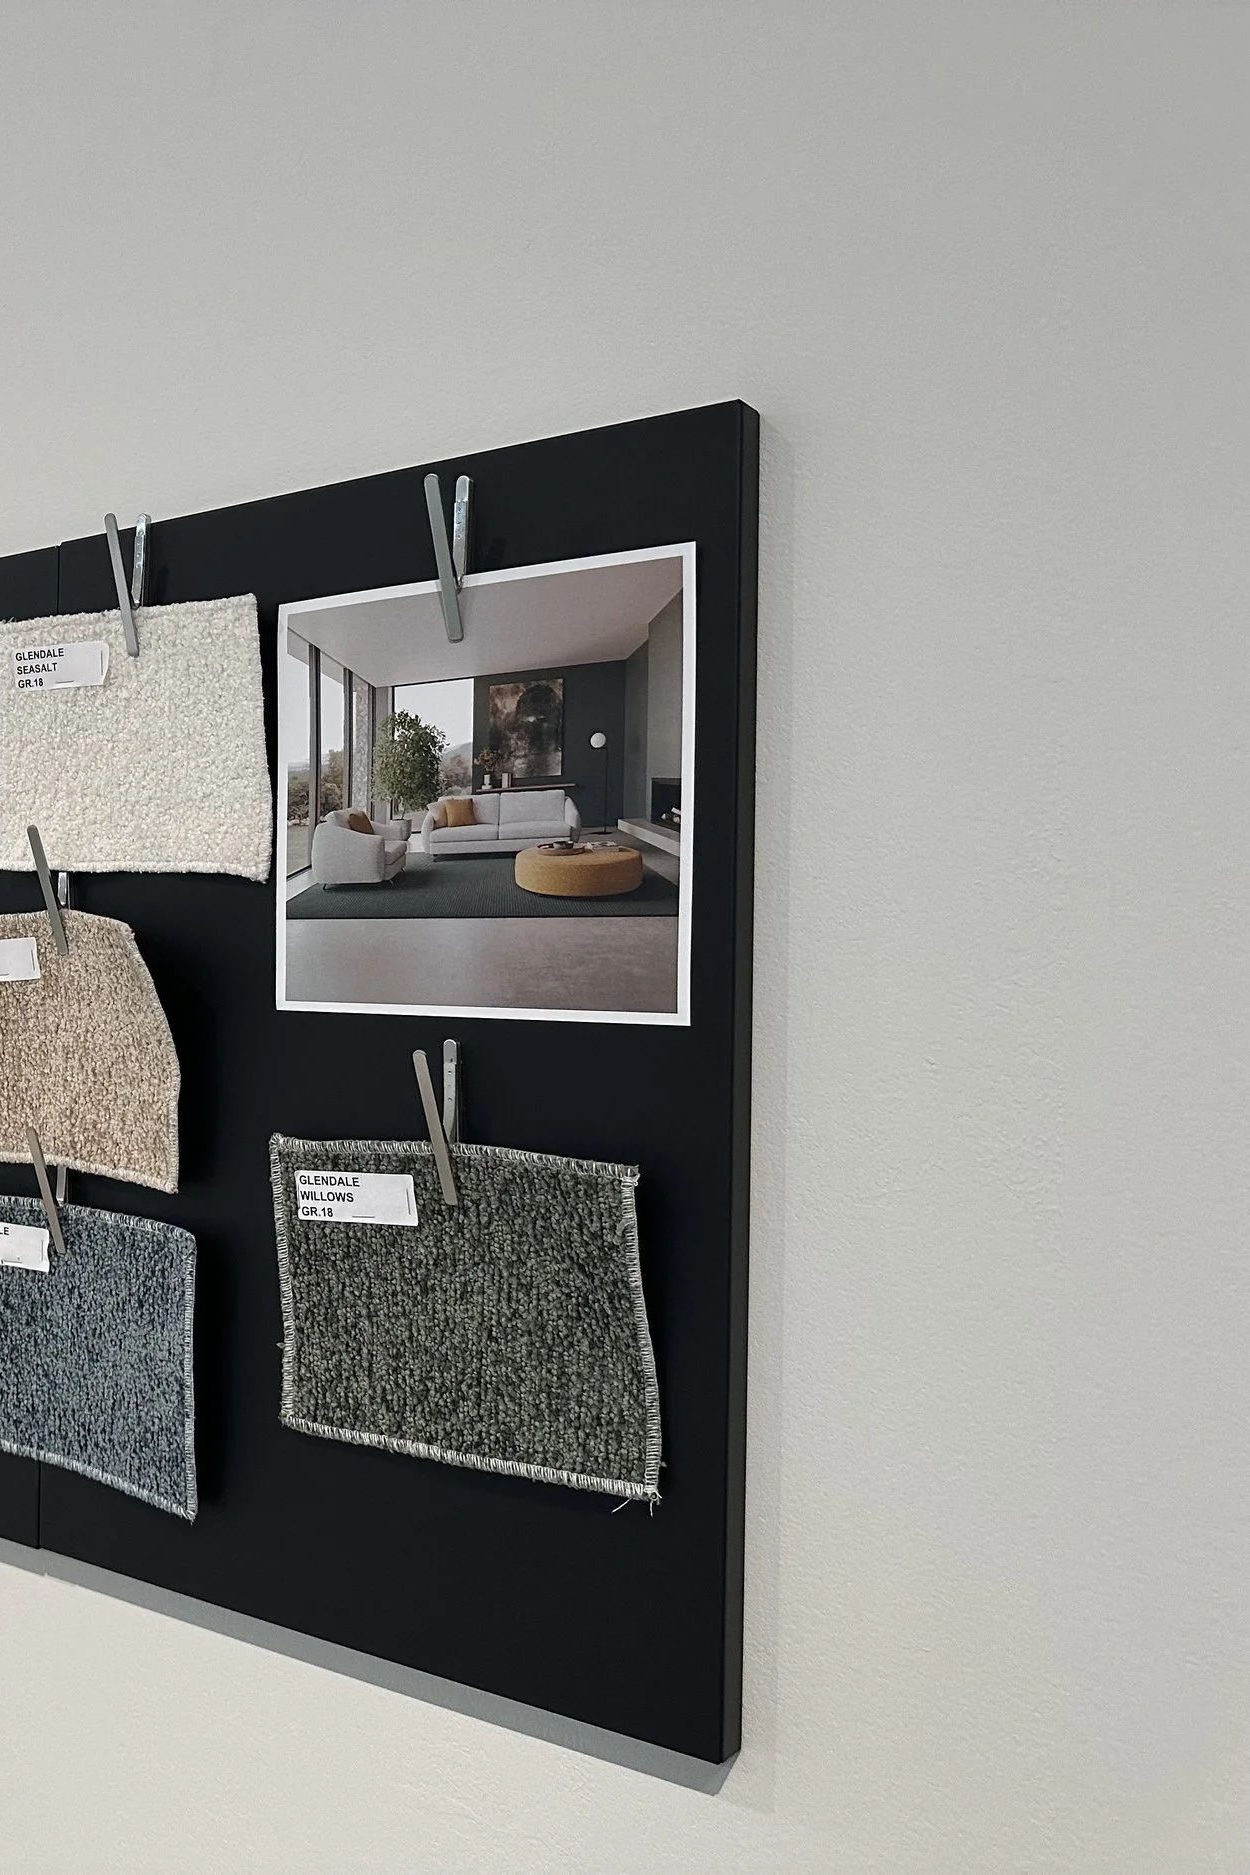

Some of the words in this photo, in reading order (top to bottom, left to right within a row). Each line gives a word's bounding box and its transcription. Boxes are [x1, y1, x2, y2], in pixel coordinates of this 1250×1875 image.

[15, 647, 64, 662] GLENDALE
[16, 662, 58, 675] SEASALT
[17, 677, 44, 689] GR.18
[298, 1174, 360, 1188] GLENDALE
[299, 1190, 354, 1203] WILLOWS
[301, 1206, 334, 1218] GR.18
